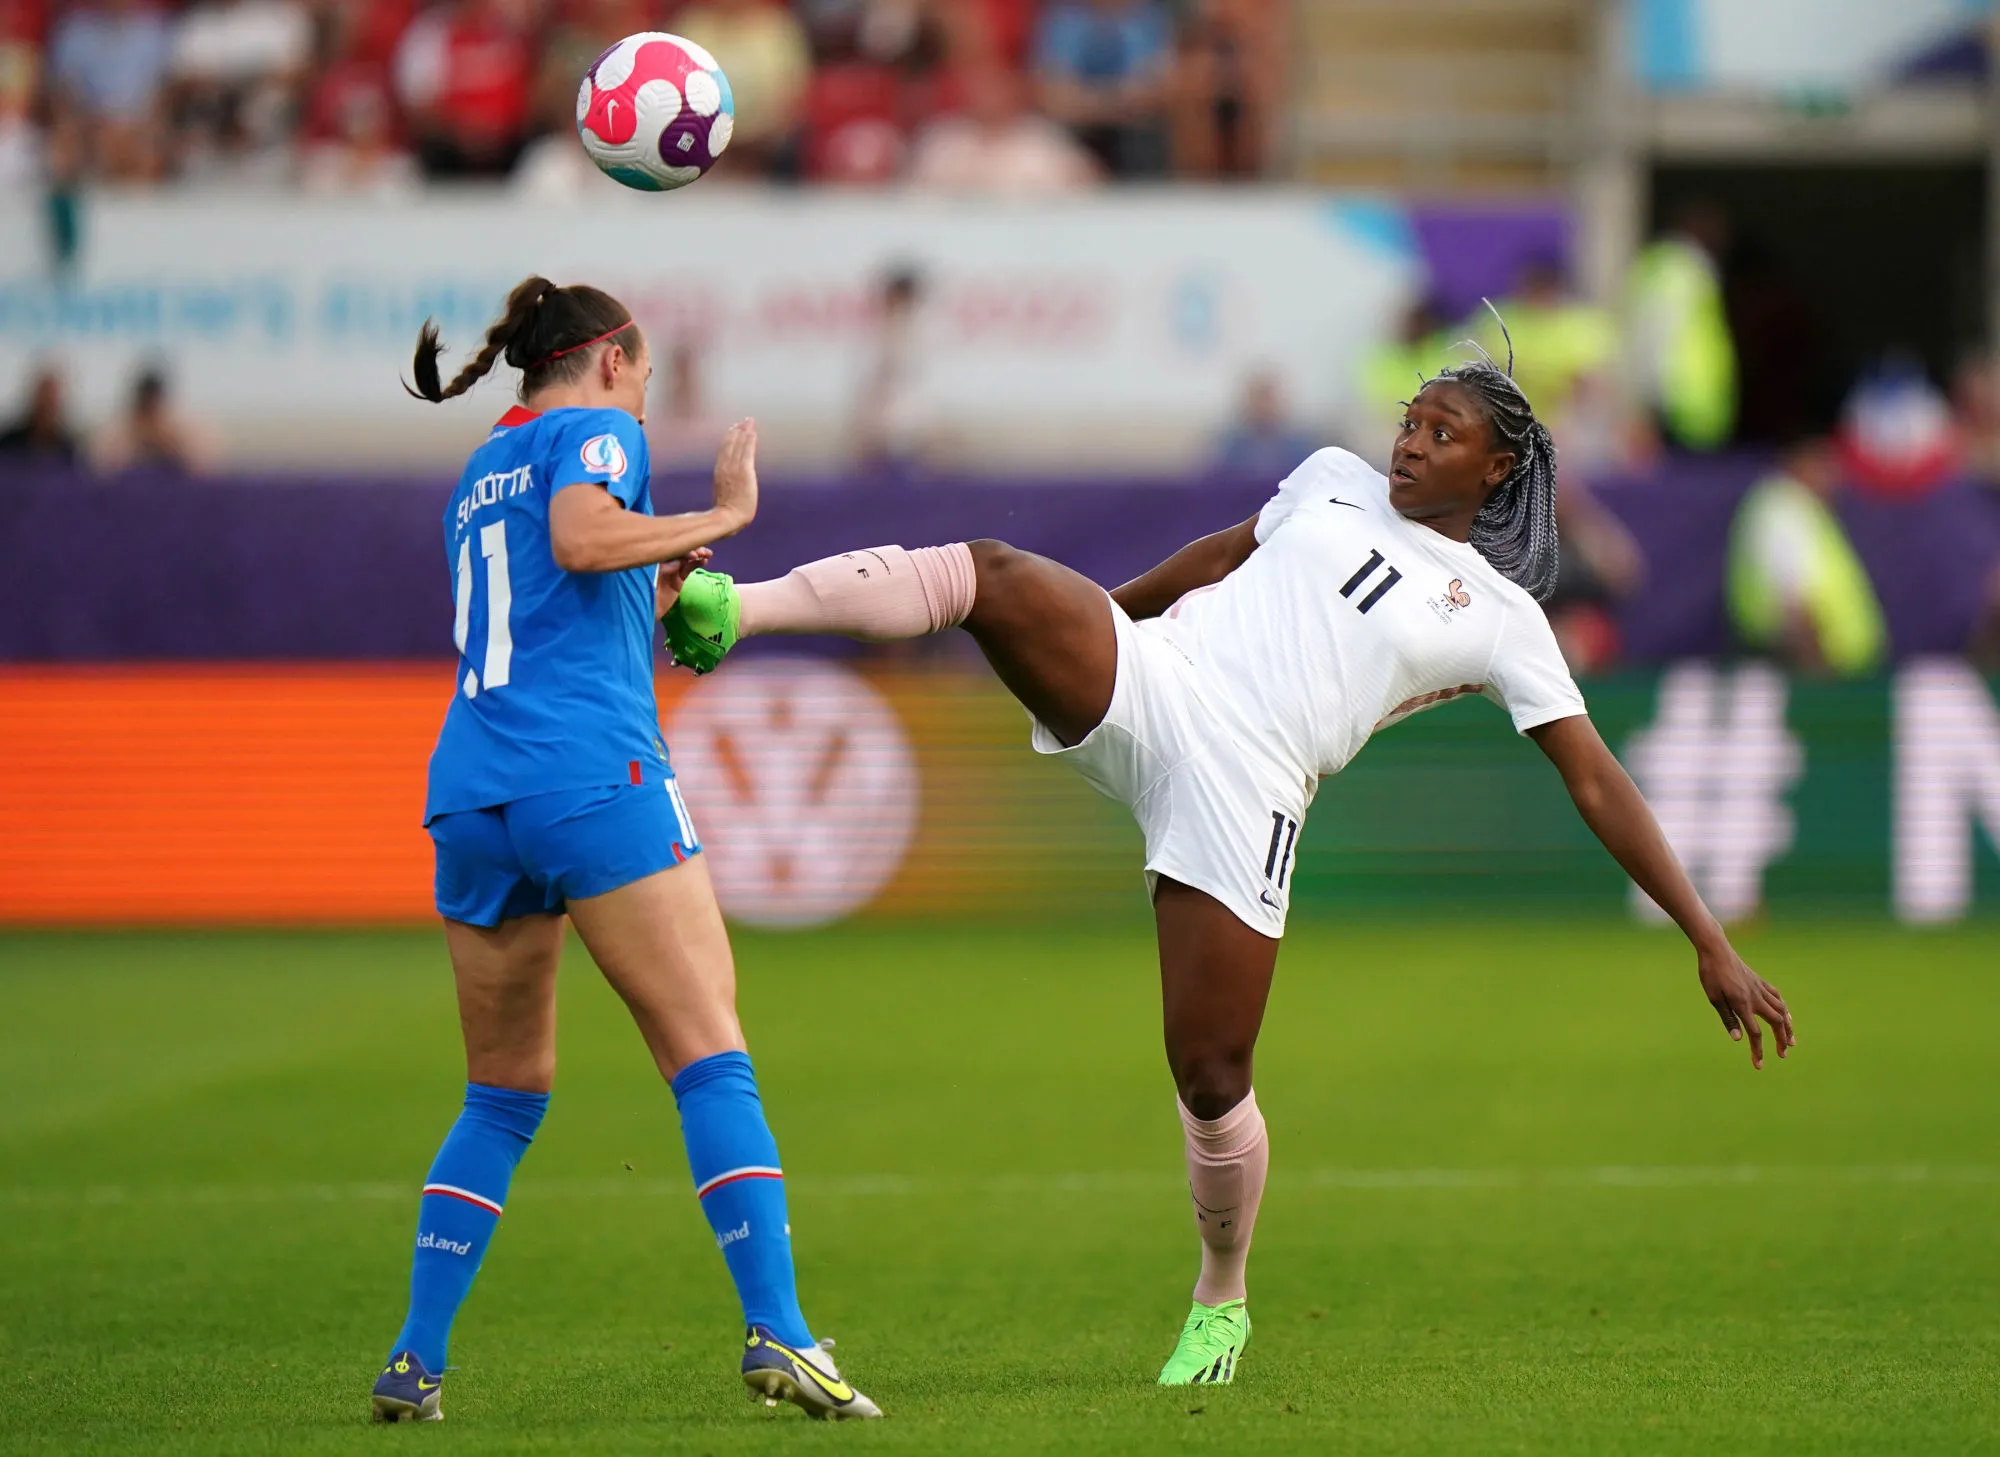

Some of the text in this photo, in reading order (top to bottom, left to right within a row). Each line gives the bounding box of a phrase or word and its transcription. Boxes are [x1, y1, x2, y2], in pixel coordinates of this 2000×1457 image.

[455, 519, 513, 699] 11
[1339, 548, 1403, 615] 11
[1264, 810, 1297, 890] 11
